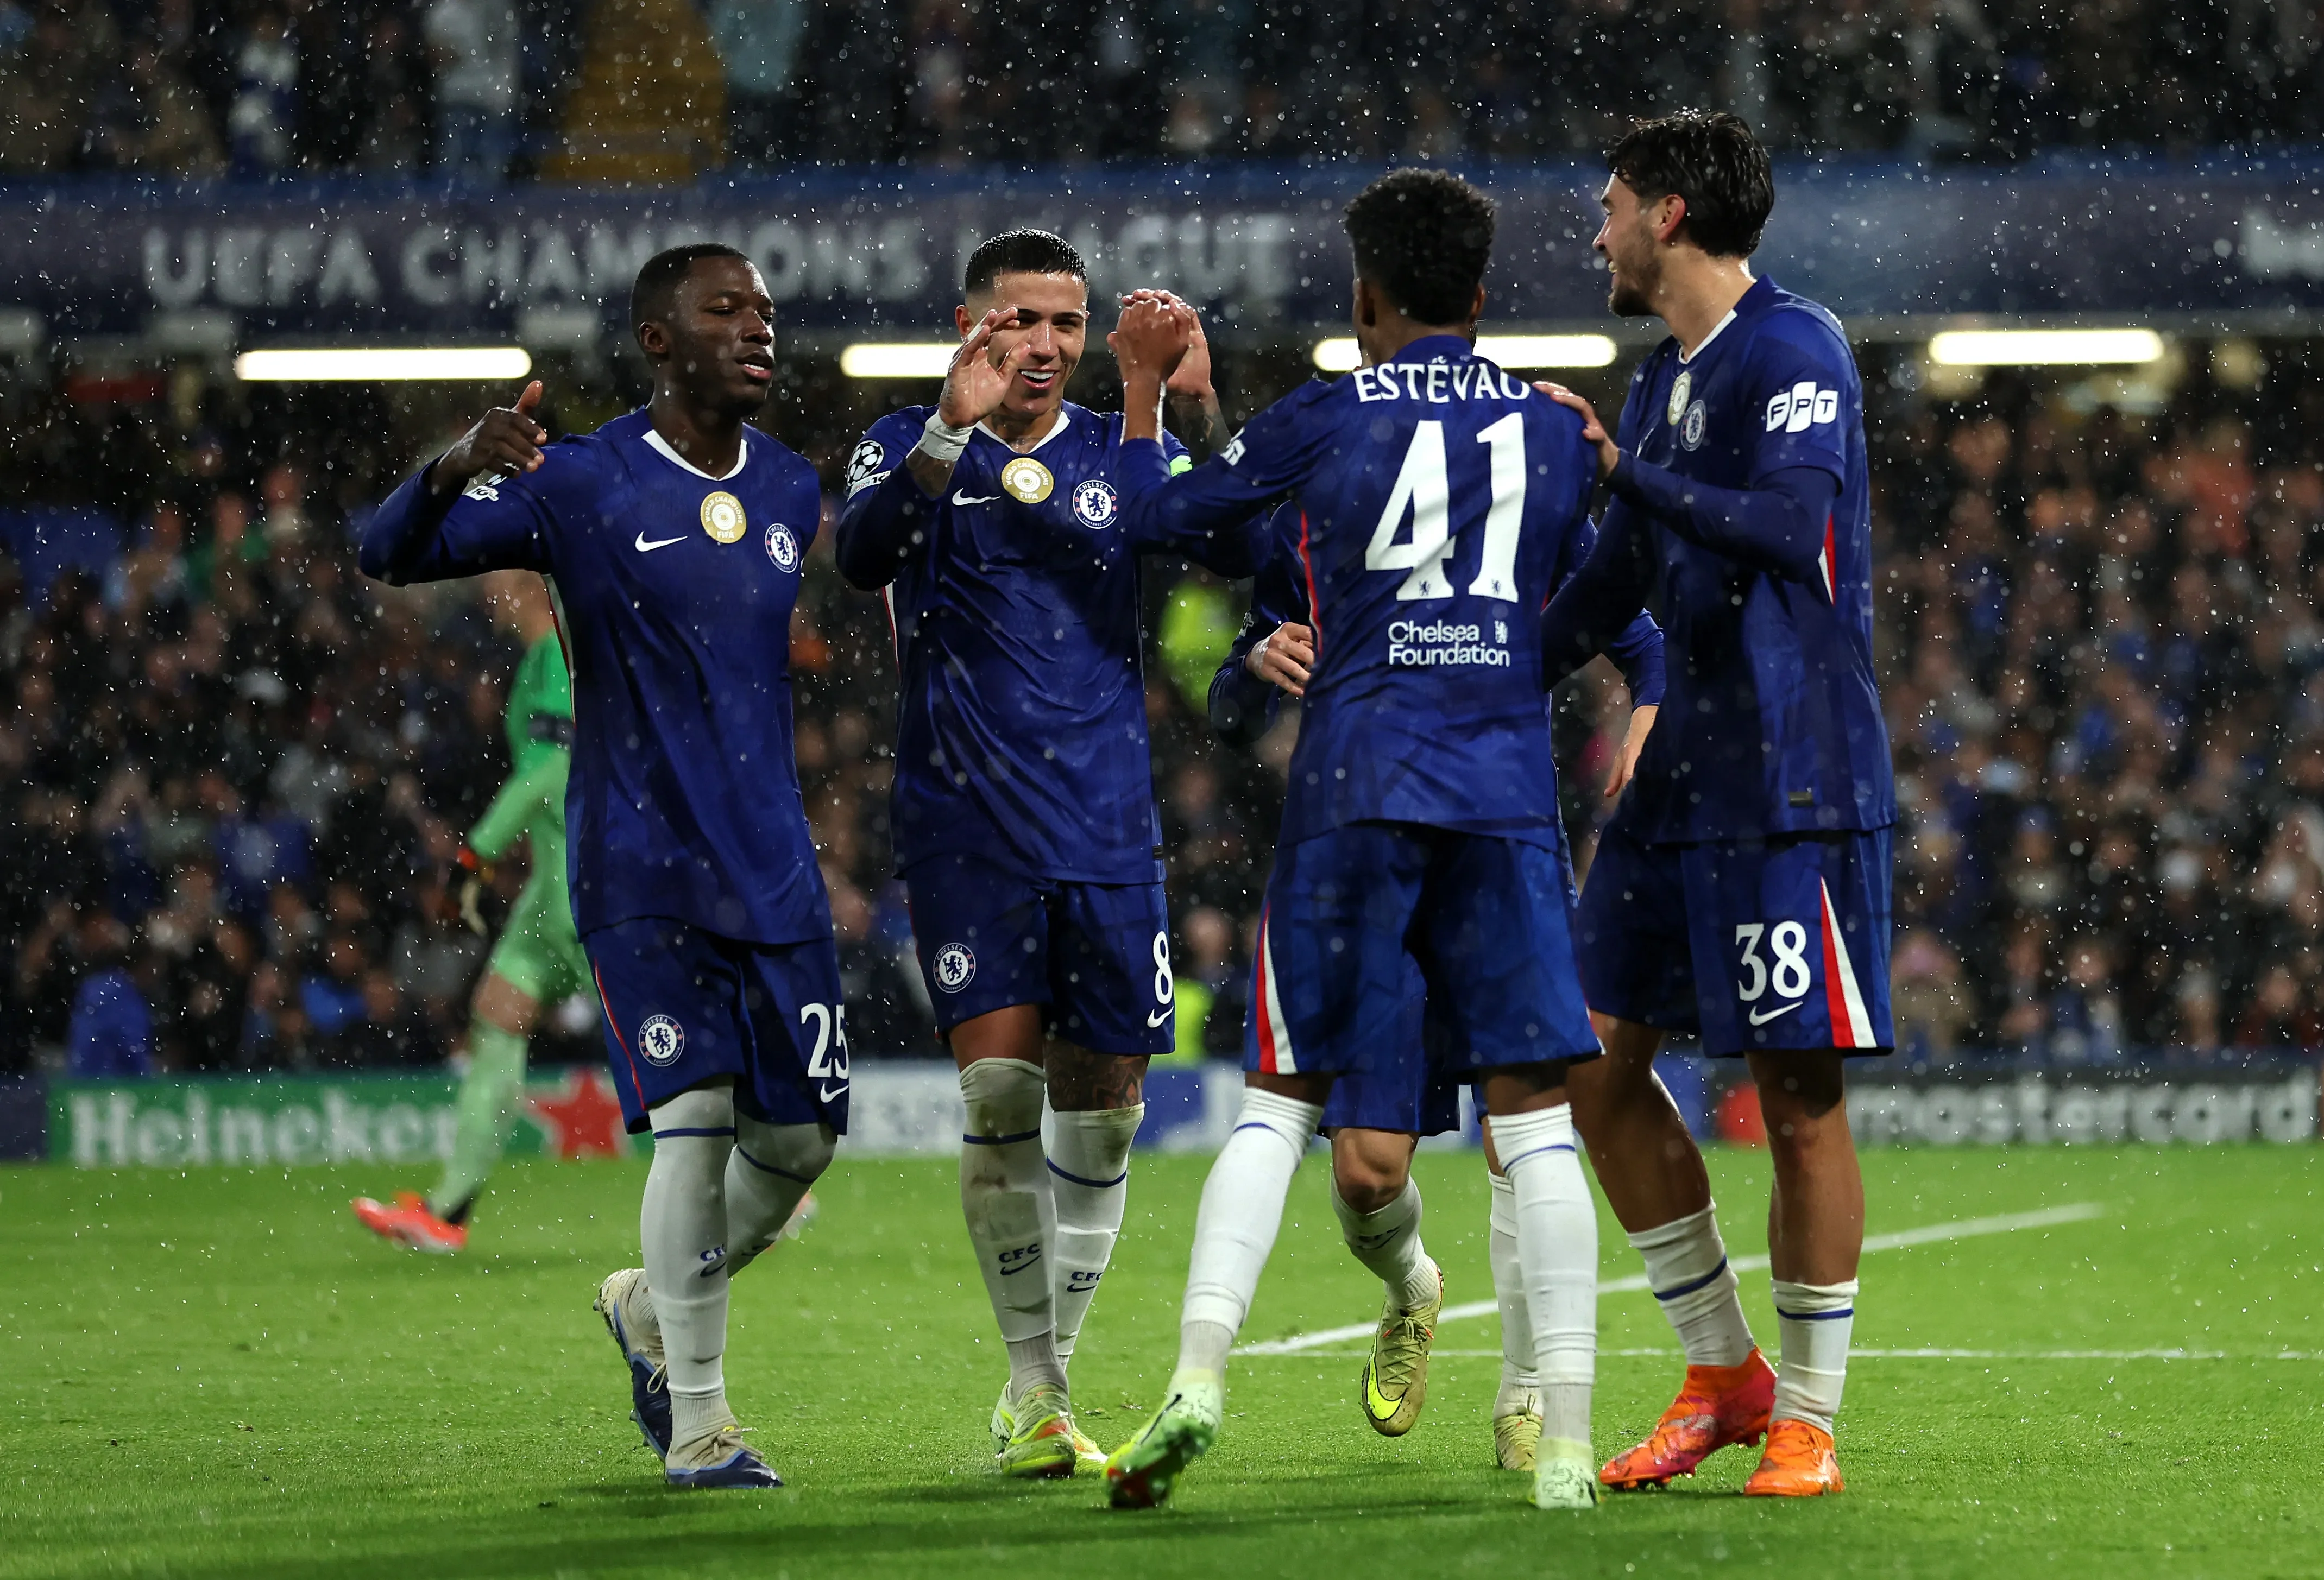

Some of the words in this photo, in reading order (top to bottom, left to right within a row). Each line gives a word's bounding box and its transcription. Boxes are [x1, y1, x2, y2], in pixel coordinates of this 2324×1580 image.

[142, 225, 380, 305] UEFA
[1017, 462, 1049, 486] CHAMPIONS
[1079, 482, 1109, 492] CHELSEA
[1365, 412, 1527, 604] 41
[717, 530, 735, 539] FIFA
[1388, 619, 1480, 643] Chelsea
[1389, 641, 1510, 667] Foundation
[937, 945, 963, 960] CHELSEA
[1735, 920, 1811, 1001] 38
[1153, 931, 1174, 1004] 8
[641, 1016, 667, 1035] CHELSEA
[801, 1002, 849, 1079] 25
[1843, 1067, 2316, 1147] mastercard
[700, 1243, 725, 1262] CF
[999, 1243, 1040, 1263] CFC
